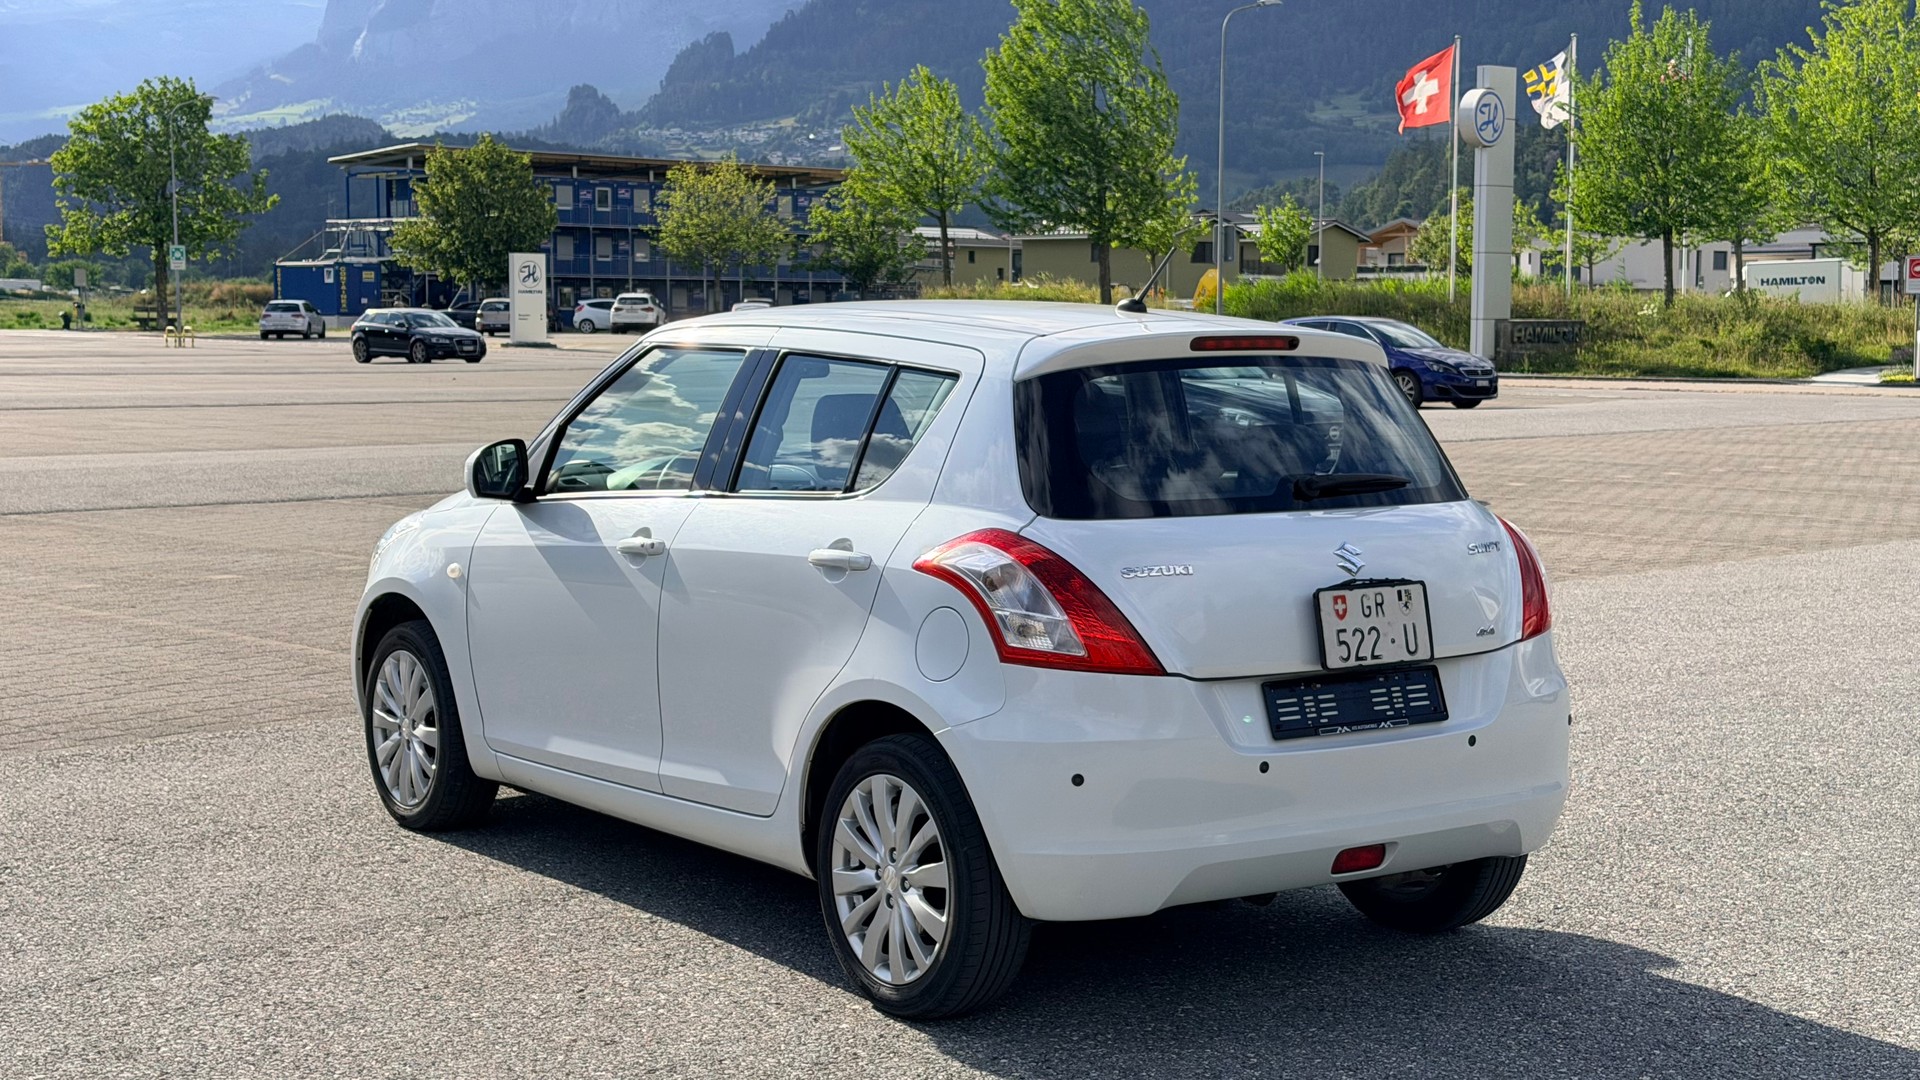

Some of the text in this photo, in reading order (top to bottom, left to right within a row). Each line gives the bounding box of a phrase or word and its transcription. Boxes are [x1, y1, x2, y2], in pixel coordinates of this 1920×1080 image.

[1760, 276, 1826, 287] HAMILTON
[1120, 563, 1194, 579] SUZUKI
[1360, 592, 1386, 619] GR
